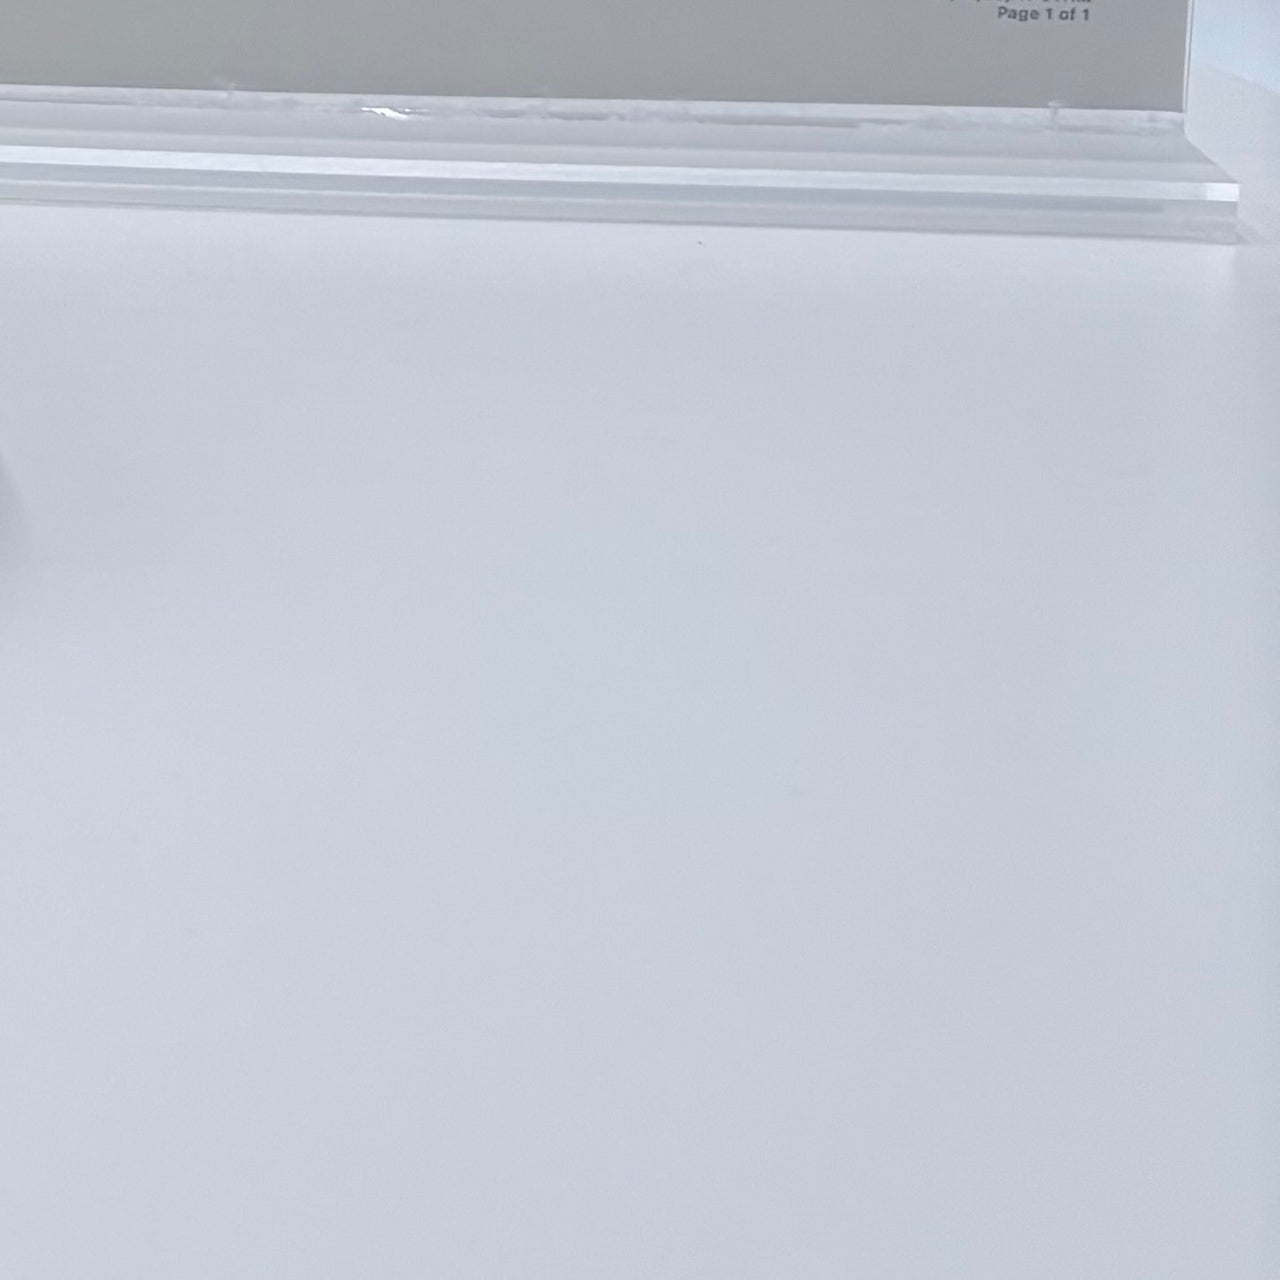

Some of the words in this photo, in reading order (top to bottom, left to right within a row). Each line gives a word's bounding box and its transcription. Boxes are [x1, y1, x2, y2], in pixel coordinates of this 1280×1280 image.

[997, 5, 1040, 22] Page
[1045, 7, 1054, 20] 1
[1058, 7, 1076, 21] of
[1082, 7, 1090, 21] 1
